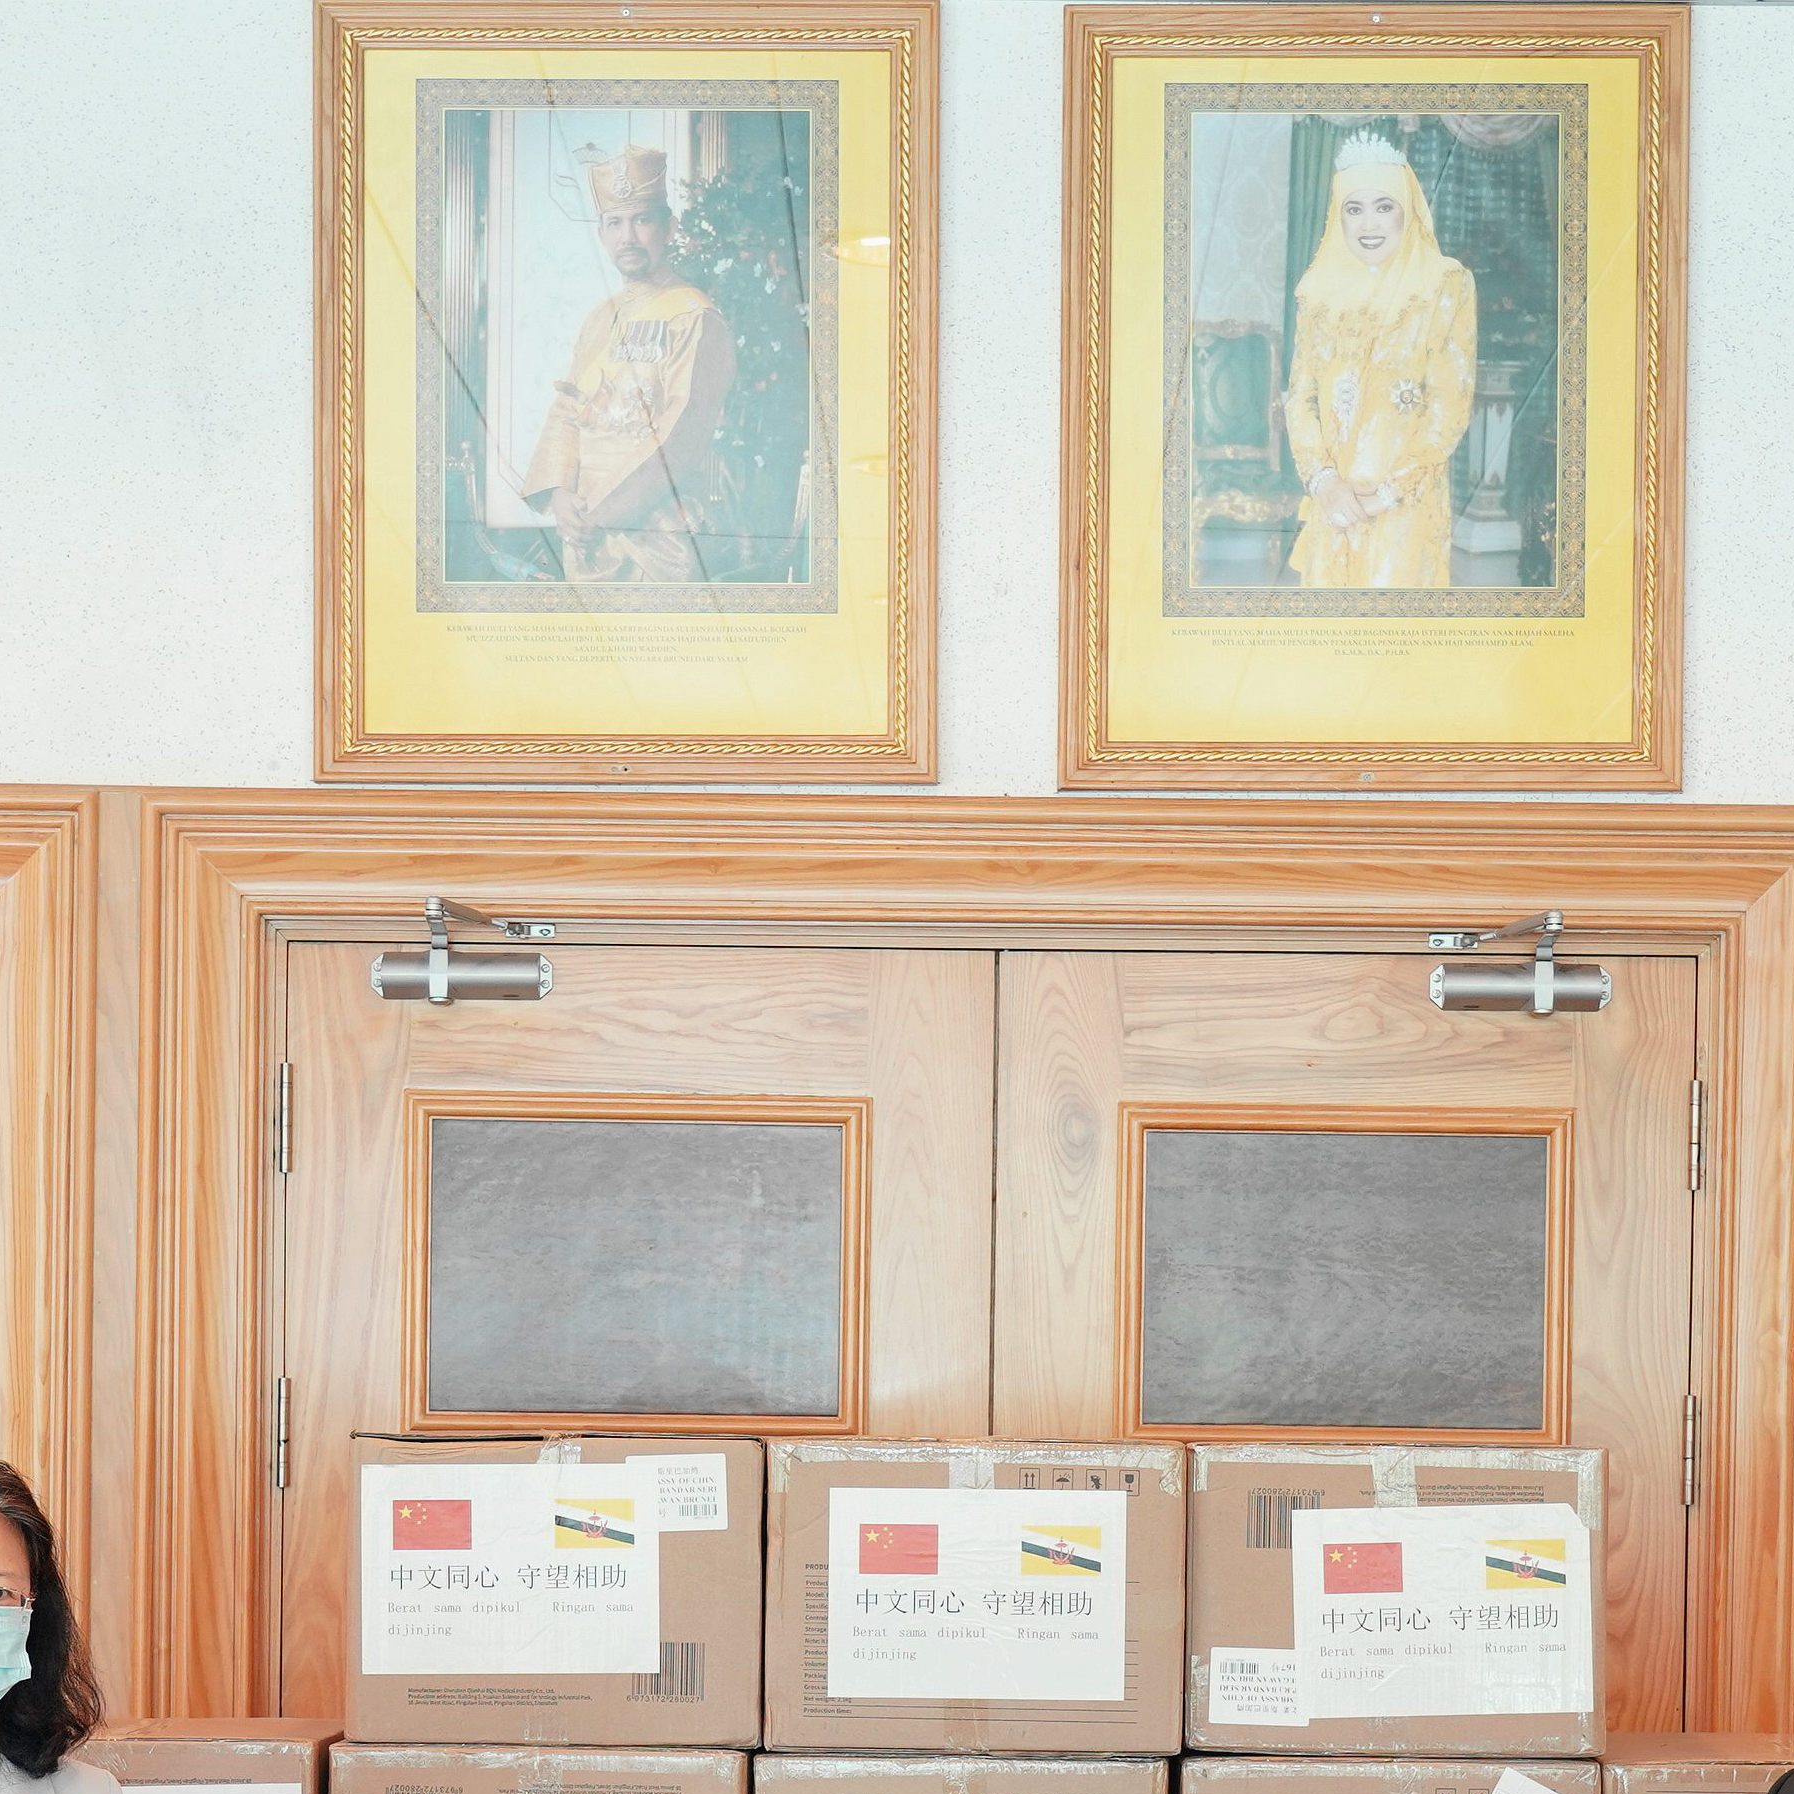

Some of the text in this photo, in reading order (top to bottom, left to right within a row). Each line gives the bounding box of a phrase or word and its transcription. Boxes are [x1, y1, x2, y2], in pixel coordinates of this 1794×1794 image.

[391, 1563, 626, 1590] 中文同心 守望相助
[387, 1600, 634, 1616] Berat sama dipikul Ringan sama
[856, 1588, 1092, 1616] 中文同心 守望相助
[1322, 1603, 1558, 1633] 中文同心 守望相助
[387, 1623, 453, 1638] dijinjing
[852, 1625, 1099, 1642] Berat sama dipikul Ringan sama
[852, 1647, 918, 1662] dijinjing
[1319, 1641, 1567, 1658] Berat sama dipikul Ringan sama
[1320, 1666, 1385, 1682] dijinjing
